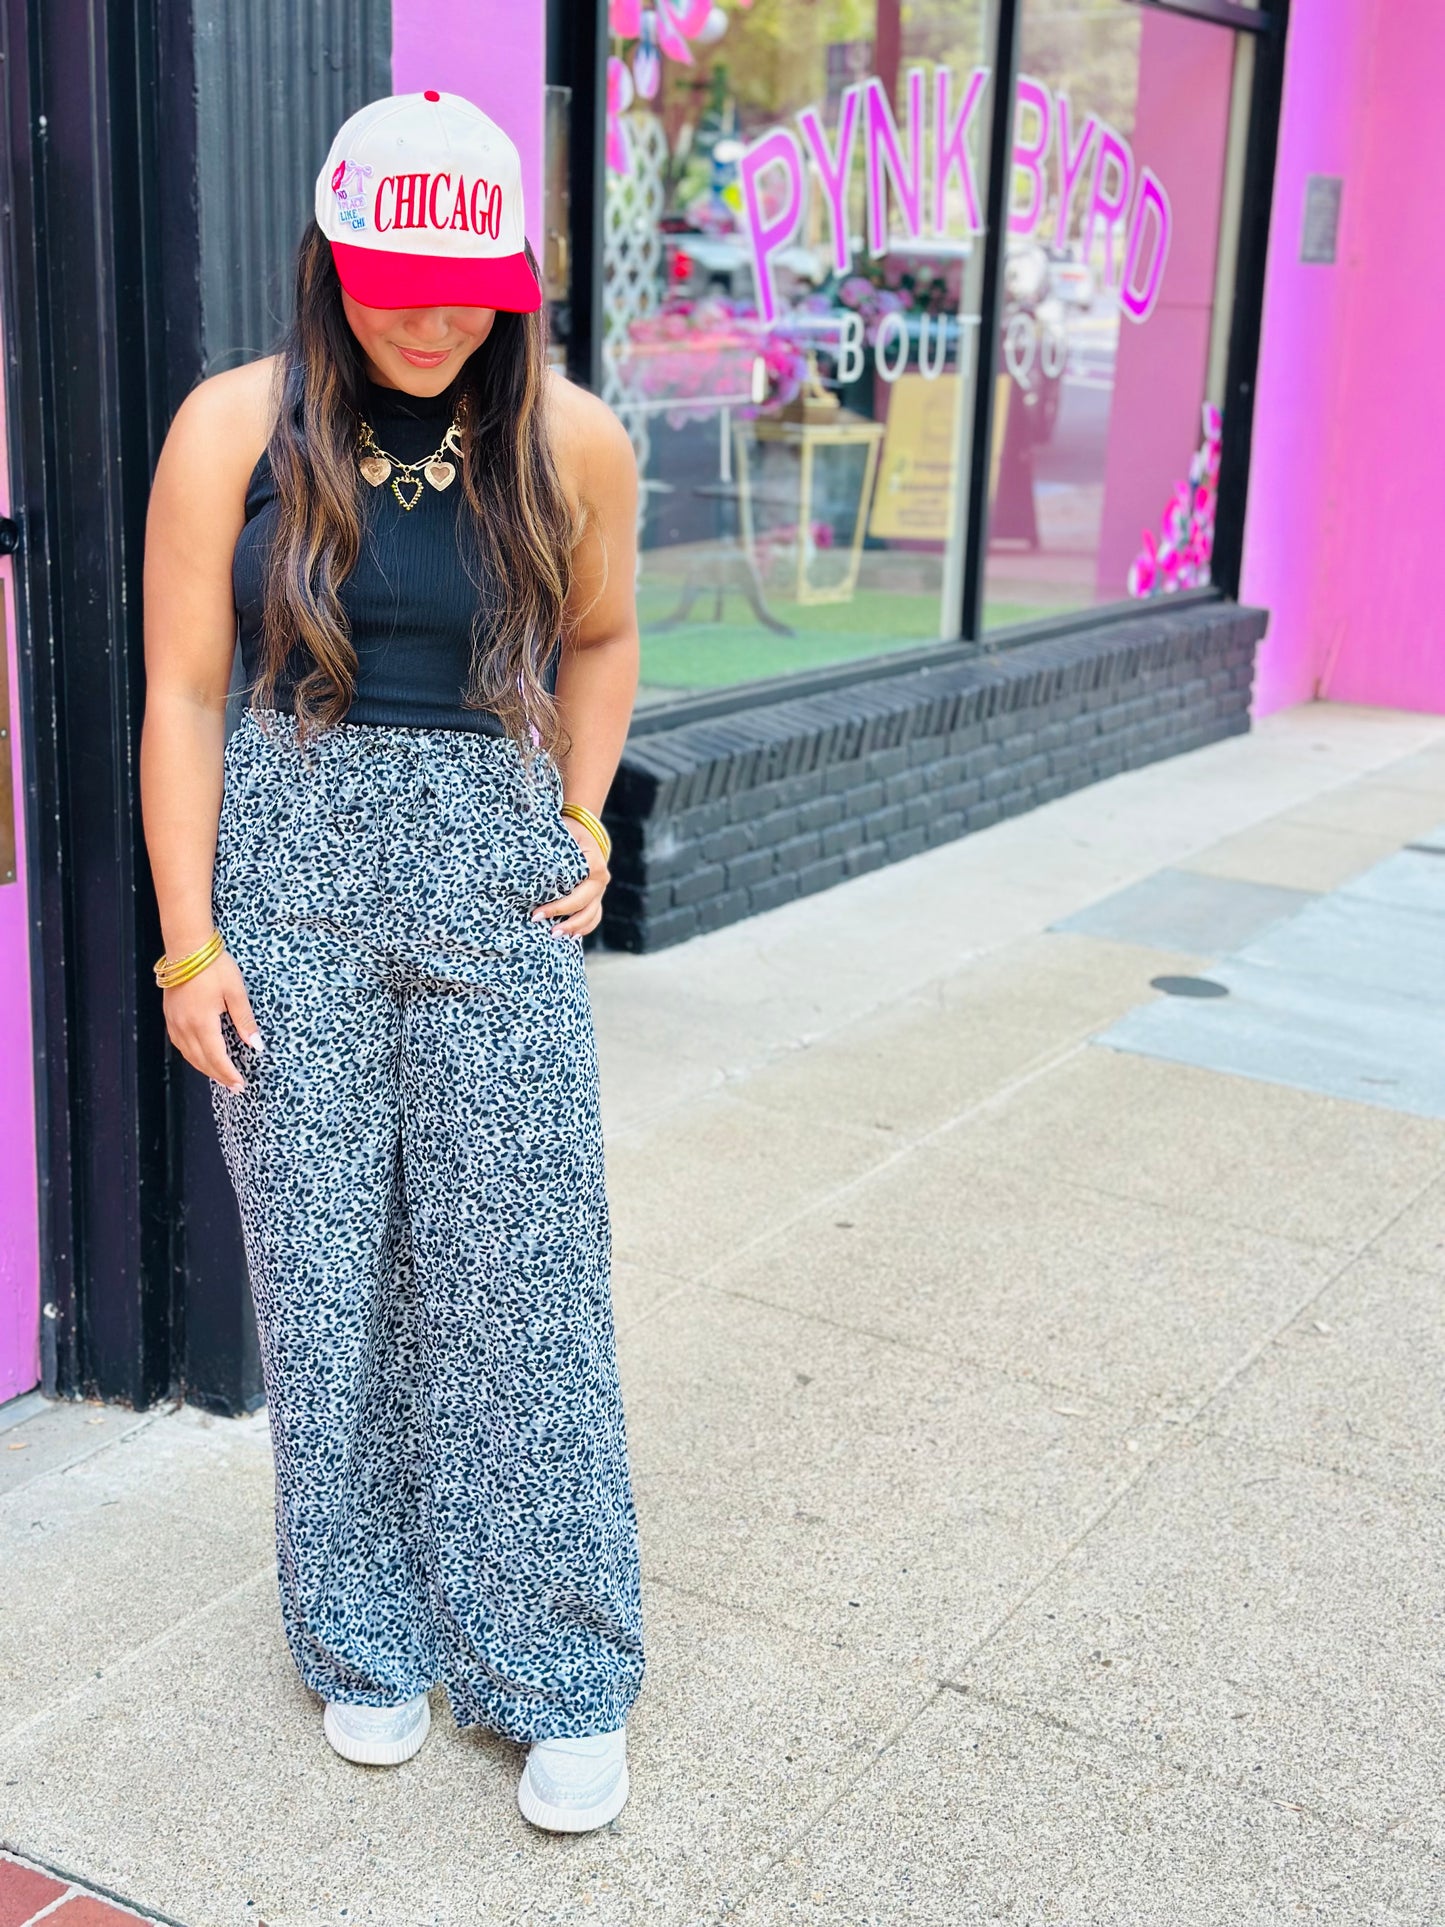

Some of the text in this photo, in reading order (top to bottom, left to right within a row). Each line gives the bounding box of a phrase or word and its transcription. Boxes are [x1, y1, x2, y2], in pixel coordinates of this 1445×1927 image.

[337, 189, 348, 200] NO
[340, 208, 358, 222] LIKE
[374, 172, 503, 240] CHICAGO
[740, 66, 1173, 332] PYNK BYRD
[352, 216, 365, 229] CHI
[838, 312, 1088, 390] BOUTQU
